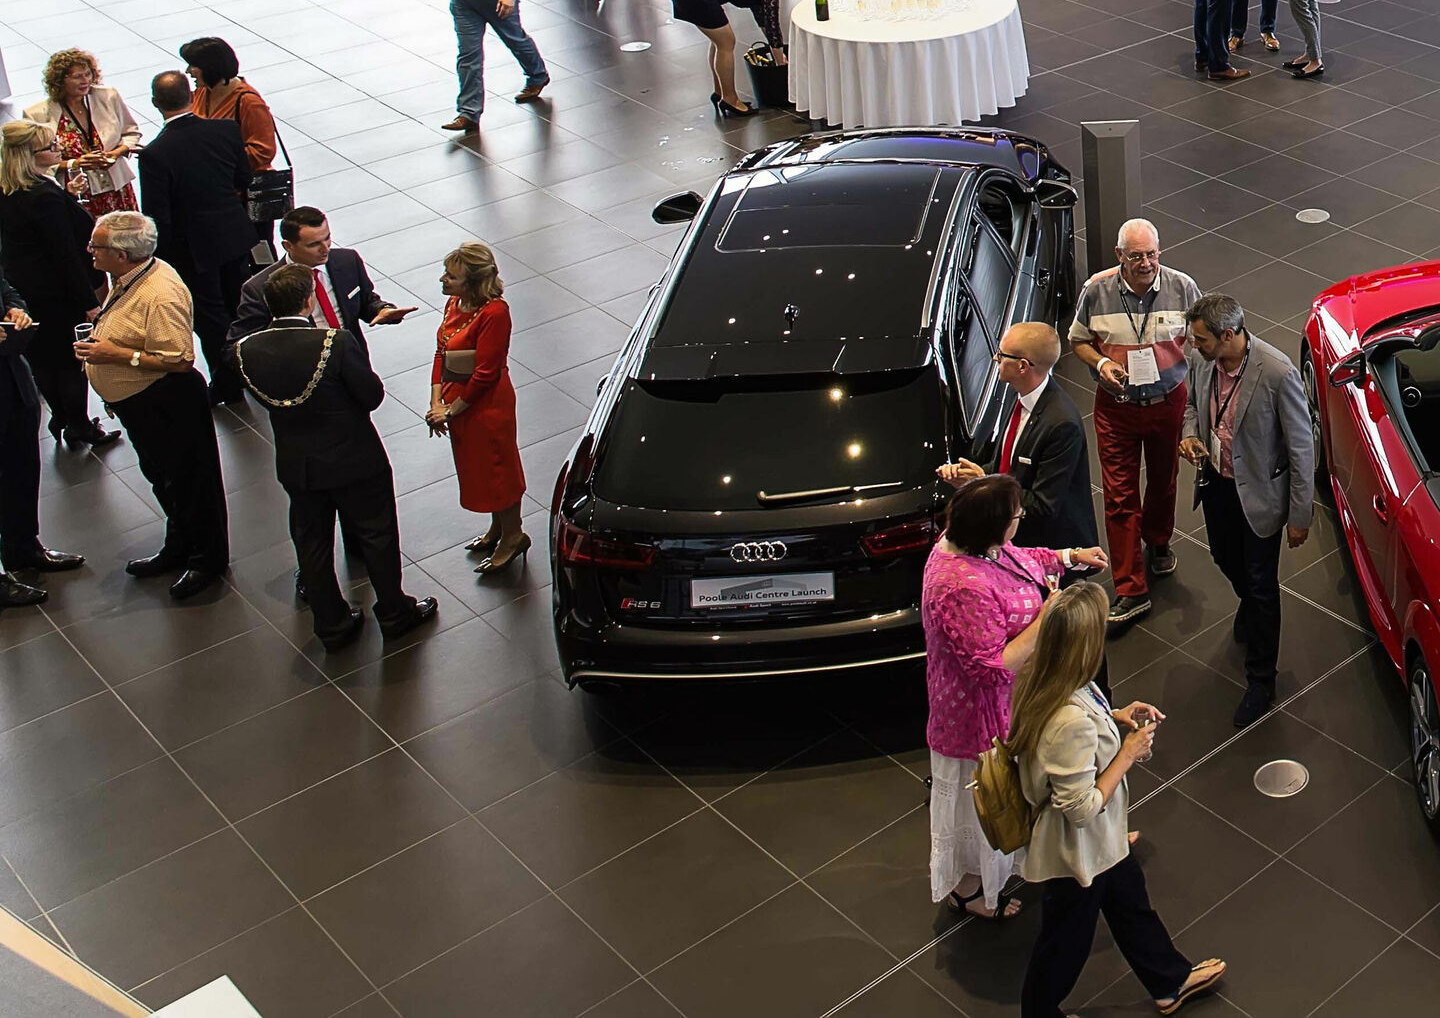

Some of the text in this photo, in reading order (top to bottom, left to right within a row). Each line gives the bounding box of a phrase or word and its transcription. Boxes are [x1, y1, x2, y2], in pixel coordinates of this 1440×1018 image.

[699, 587, 828, 603] Poole Audi Centre Launch
